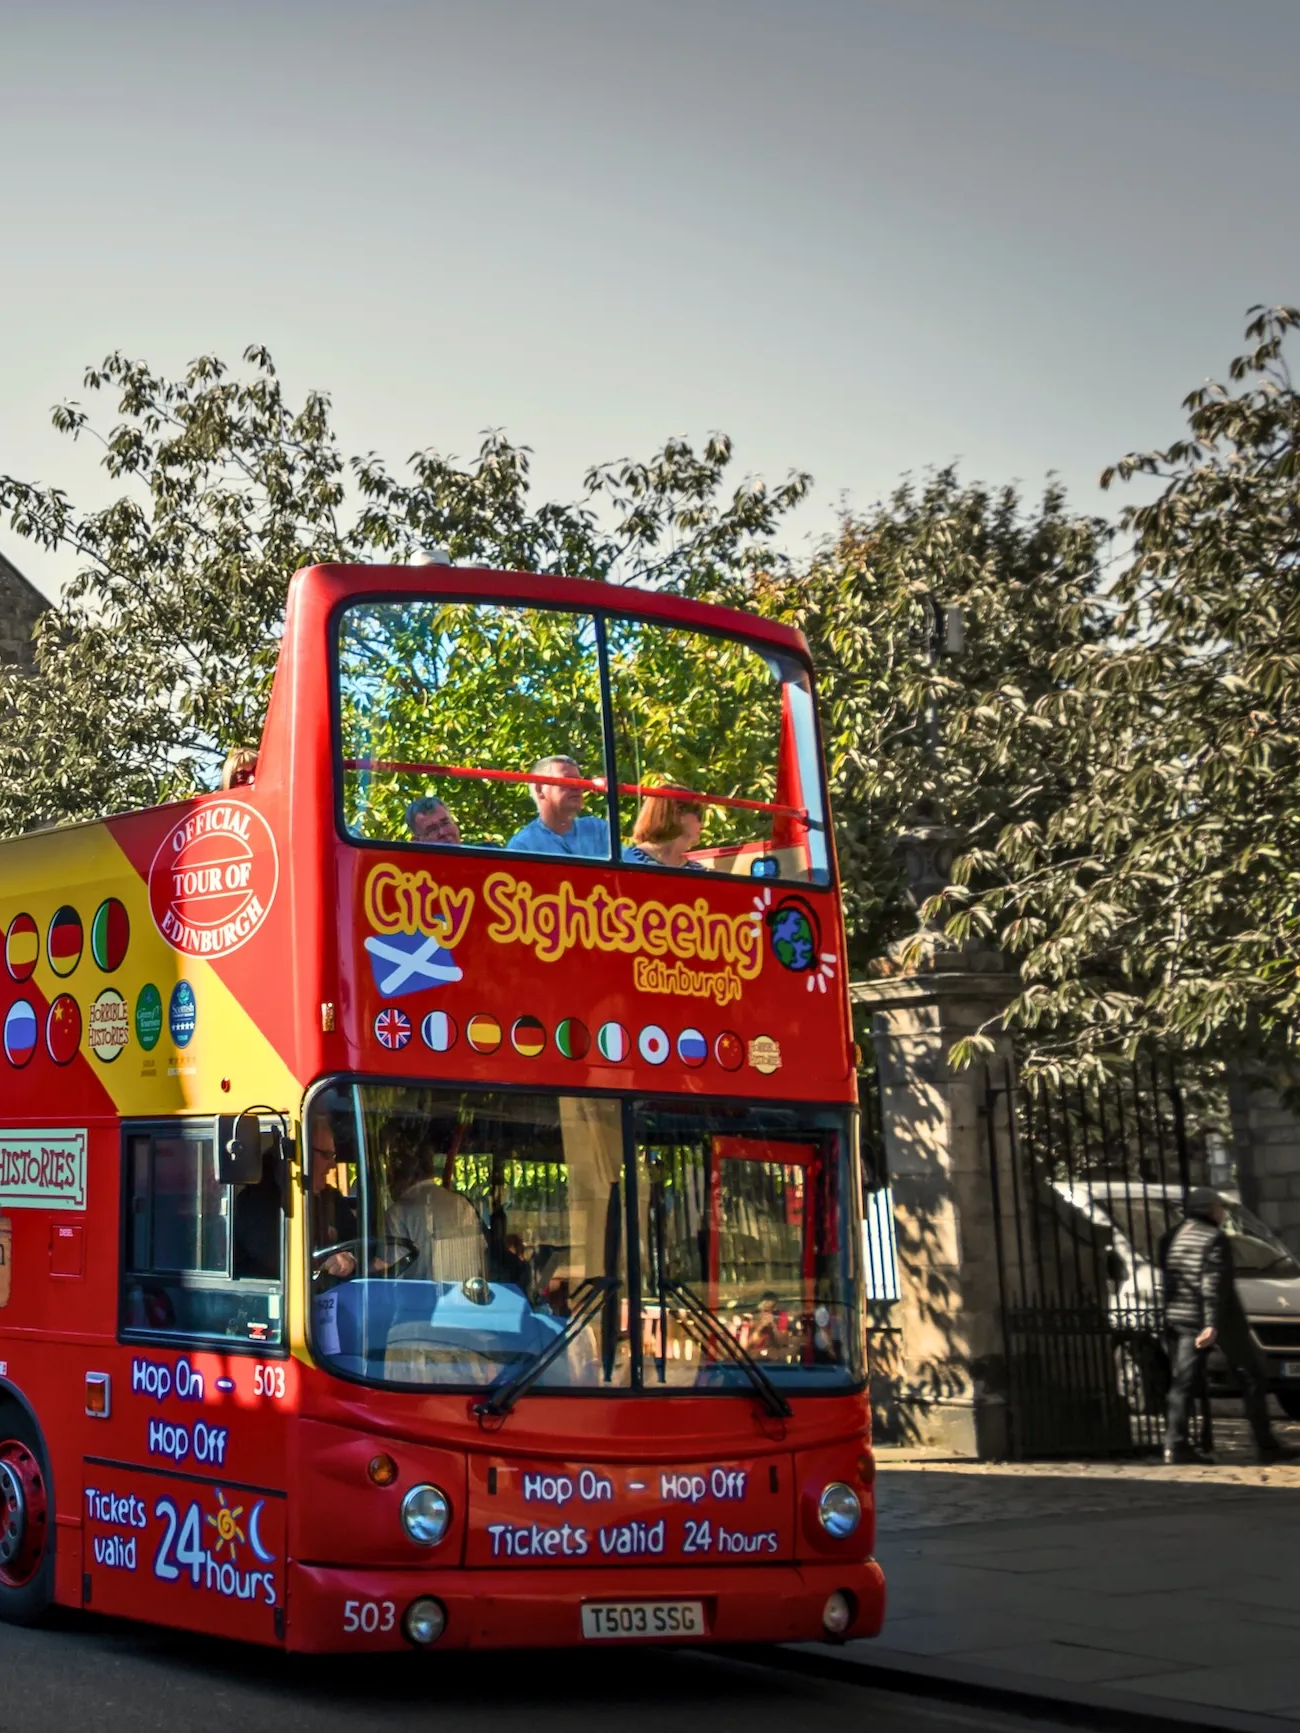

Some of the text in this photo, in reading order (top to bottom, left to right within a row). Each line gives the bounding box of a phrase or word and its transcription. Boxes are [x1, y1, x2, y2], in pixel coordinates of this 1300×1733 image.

[172, 807, 252, 852] OFFICIAL
[173, 862, 252, 897] TOUR OF
[161, 895, 264, 953] EDINBURGH
[364, 863, 764, 979] City Sightseeing
[633, 956, 743, 1006] Edinburgh
[132, 1360, 171, 1399] Hop
[175, 1359, 204, 1399] On
[253, 1364, 286, 1399] 503
[149, 1421, 227, 1463] Hop Off
[524, 1473, 573, 1504] Hop
[579, 1470, 612, 1500] On
[660, 1472, 706, 1502] Hop
[710, 1468, 747, 1500] Off
[84, 1489, 147, 1528] Tickets
[94, 1536, 137, 1569] valid
[155, 1501, 206, 1583] 24
[488, 1520, 778, 1557] Tickets valid 24 hours
[206, 1550, 276, 1605] hours
[342, 1600, 396, 1633] 503
[590, 1605, 696, 1633] T503 SSG
